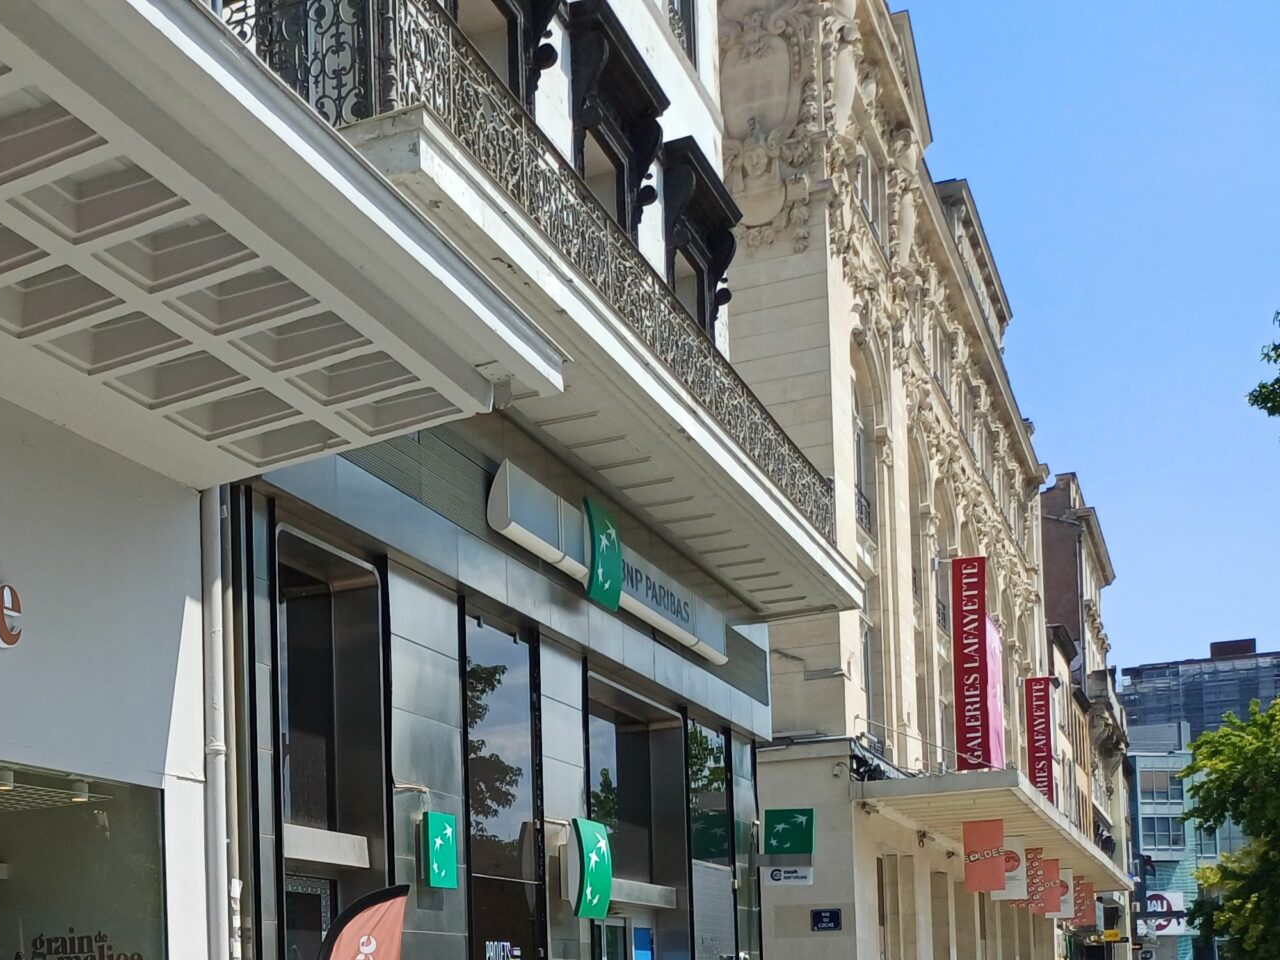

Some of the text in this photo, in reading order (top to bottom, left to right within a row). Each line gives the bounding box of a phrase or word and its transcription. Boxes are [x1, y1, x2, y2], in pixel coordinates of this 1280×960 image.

[645, 574, 691, 624] PARIBAS
[961, 562, 984, 765] GALERIES LAFAYETTE
[1032, 680, 1047, 757] LAFAYETTE
[94, 930, 109, 944] de
